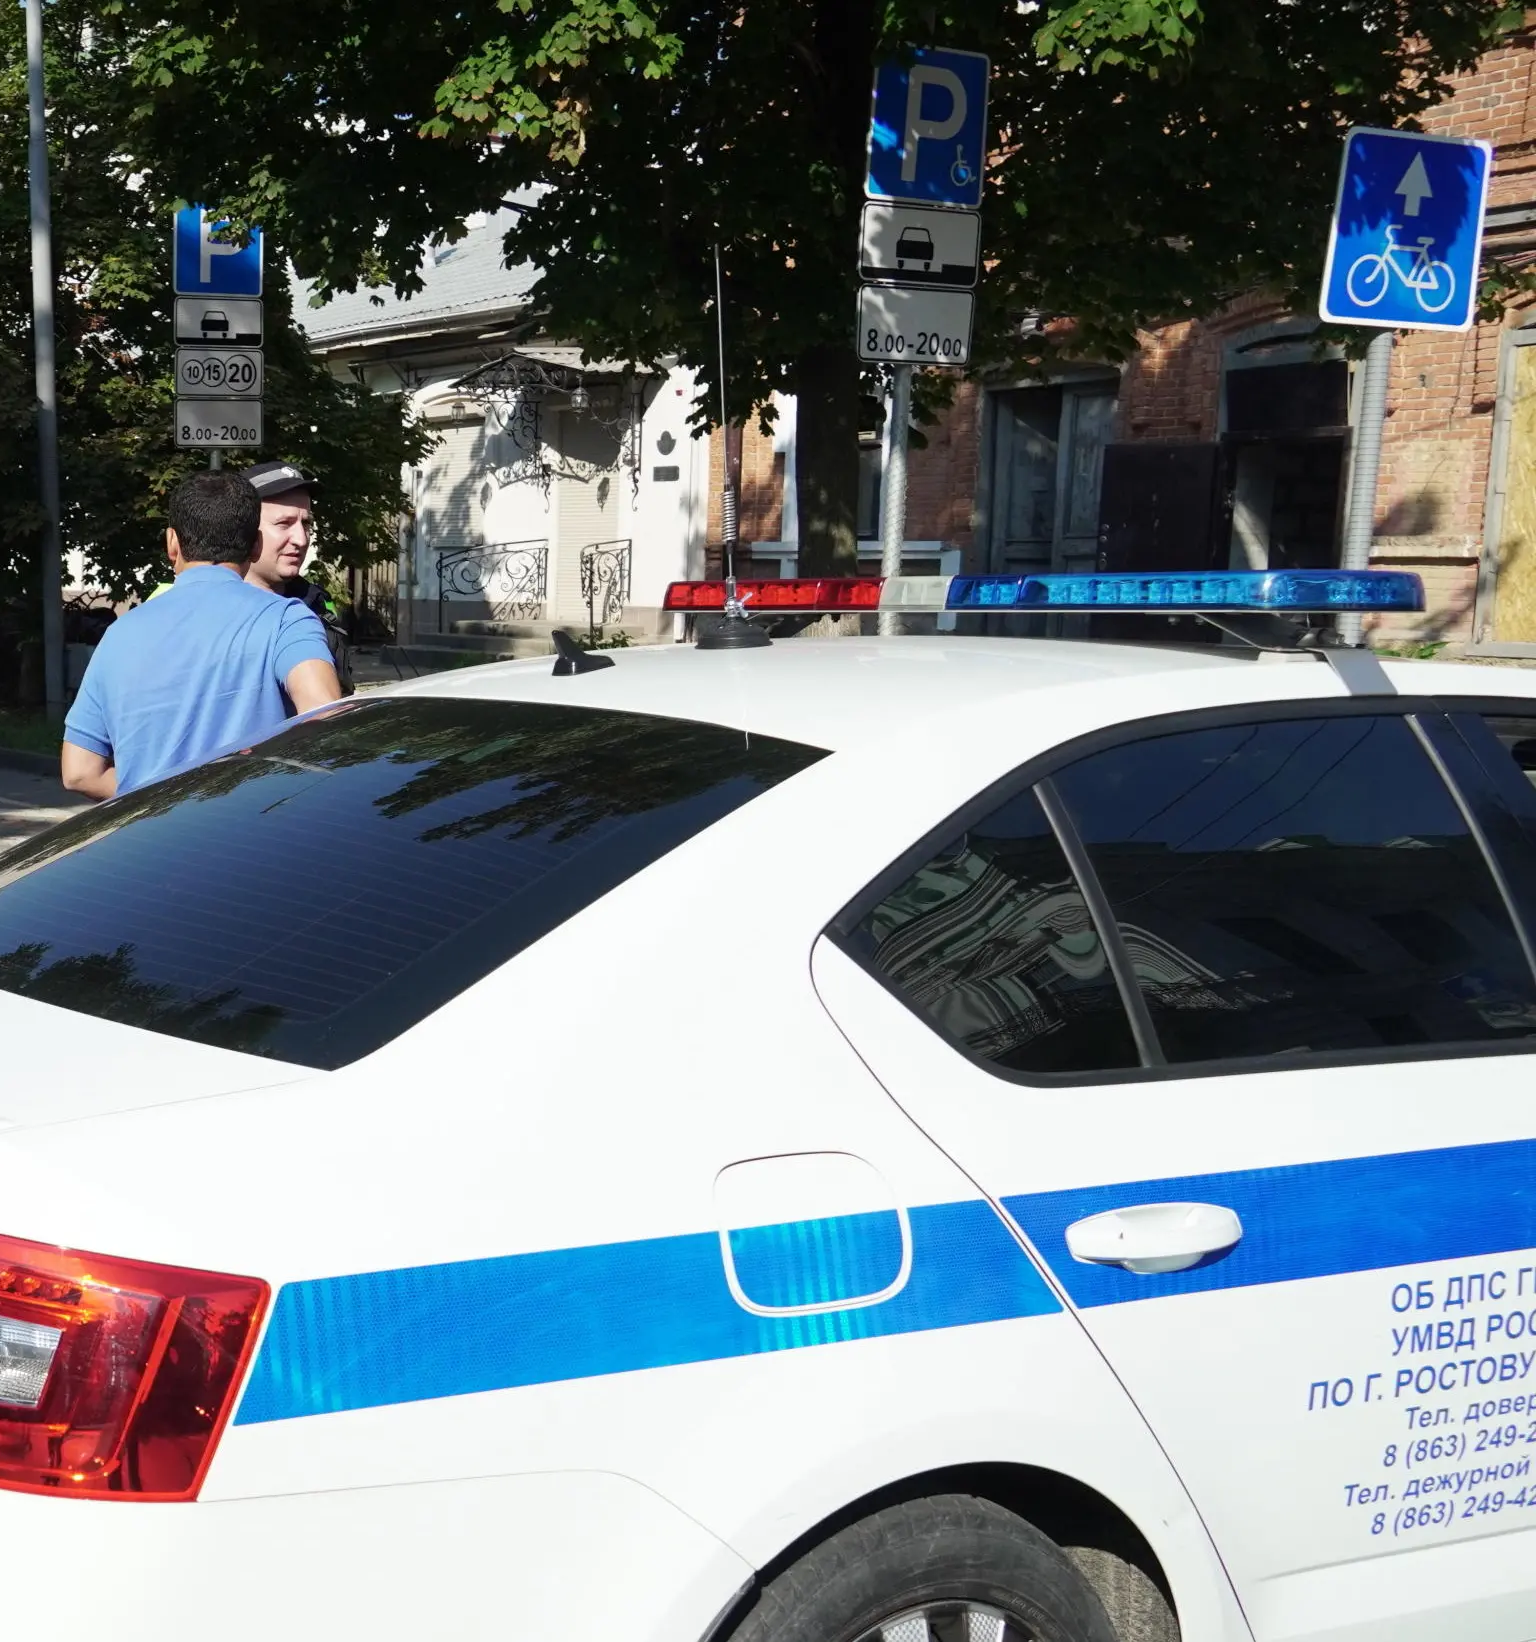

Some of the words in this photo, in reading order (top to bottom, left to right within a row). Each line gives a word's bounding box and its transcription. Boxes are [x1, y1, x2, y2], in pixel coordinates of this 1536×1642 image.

[901, 64, 967, 181] P
[186, 366, 200, 379] 10
[205, 364, 221, 381] 15
[228, 363, 253, 383] 20
[1391, 1280, 1434, 1313] ОБ
[1444, 1271, 1506, 1311] ДПС
[1391, 1318, 1475, 1356] УМВД
[1308, 1378, 1353, 1410] ПО
[1363, 1374, 1383, 1401] Г.
[1406, 1406, 1455, 1429] Тел.
[1383, 1444, 1397, 1467] 8
[1406, 1432, 1466, 1469] (863)
[1344, 1484, 1396, 1507] Тел.
[1402, 1455, 1531, 1498] дежурной
[1371, 1512, 1386, 1535] 8
[1393, 1499, 1455, 1536] (863)
